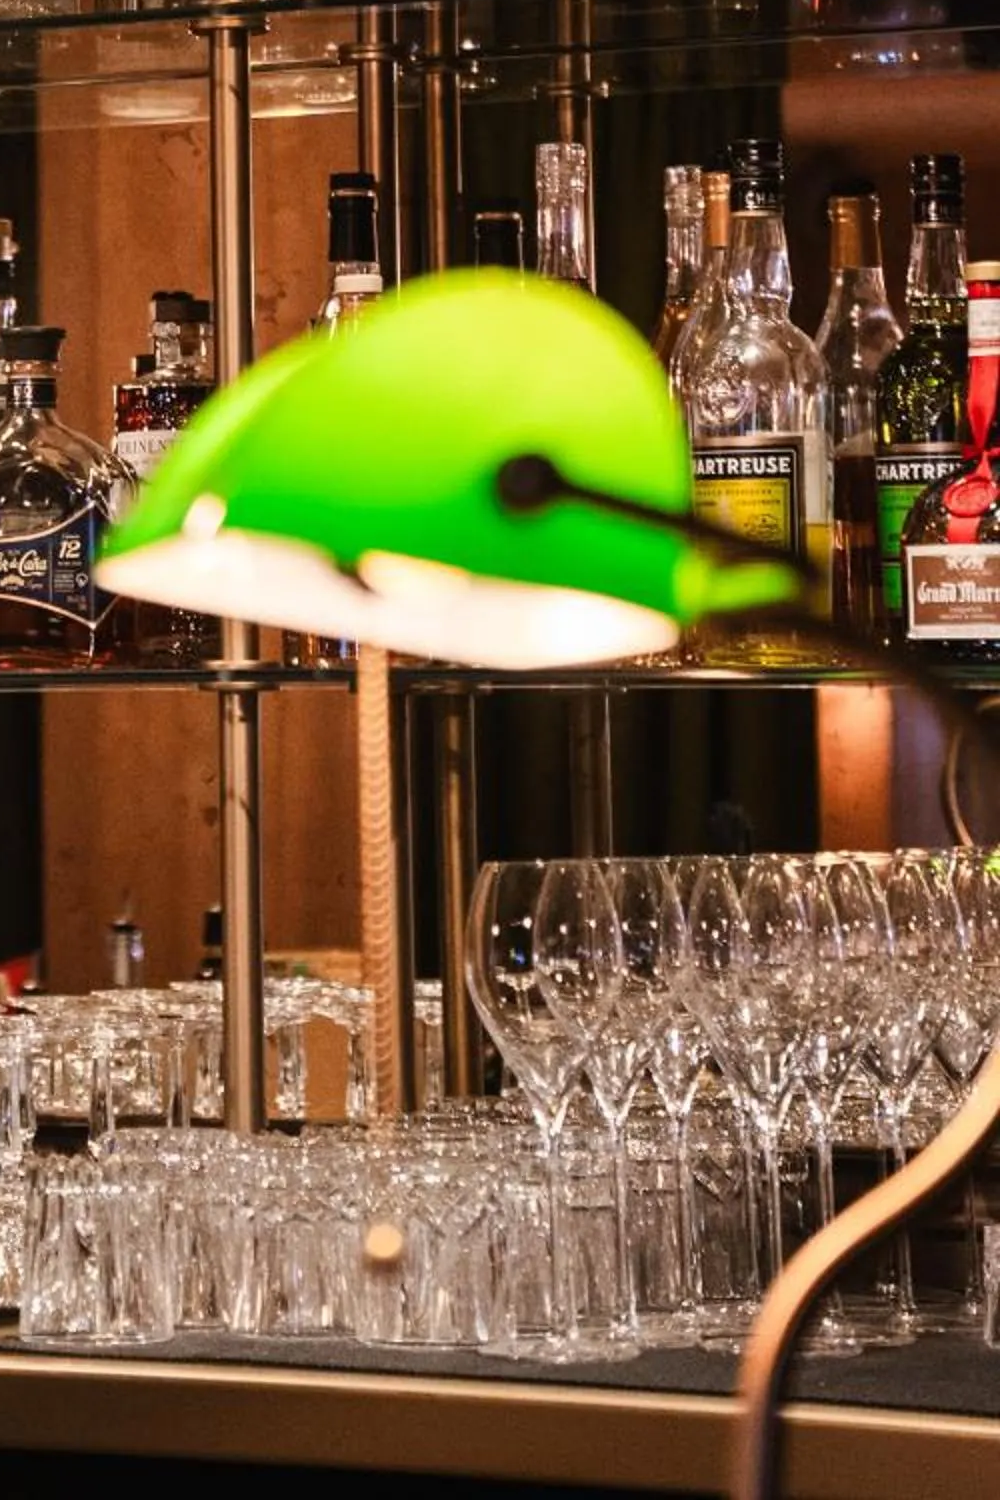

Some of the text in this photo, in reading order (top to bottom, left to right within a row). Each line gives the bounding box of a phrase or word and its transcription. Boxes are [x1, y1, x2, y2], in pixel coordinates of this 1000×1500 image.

[691, 456, 791, 475] ARTREUSE
[59, 539, 81, 560] 12
[917, 581, 957, 605] Grand
